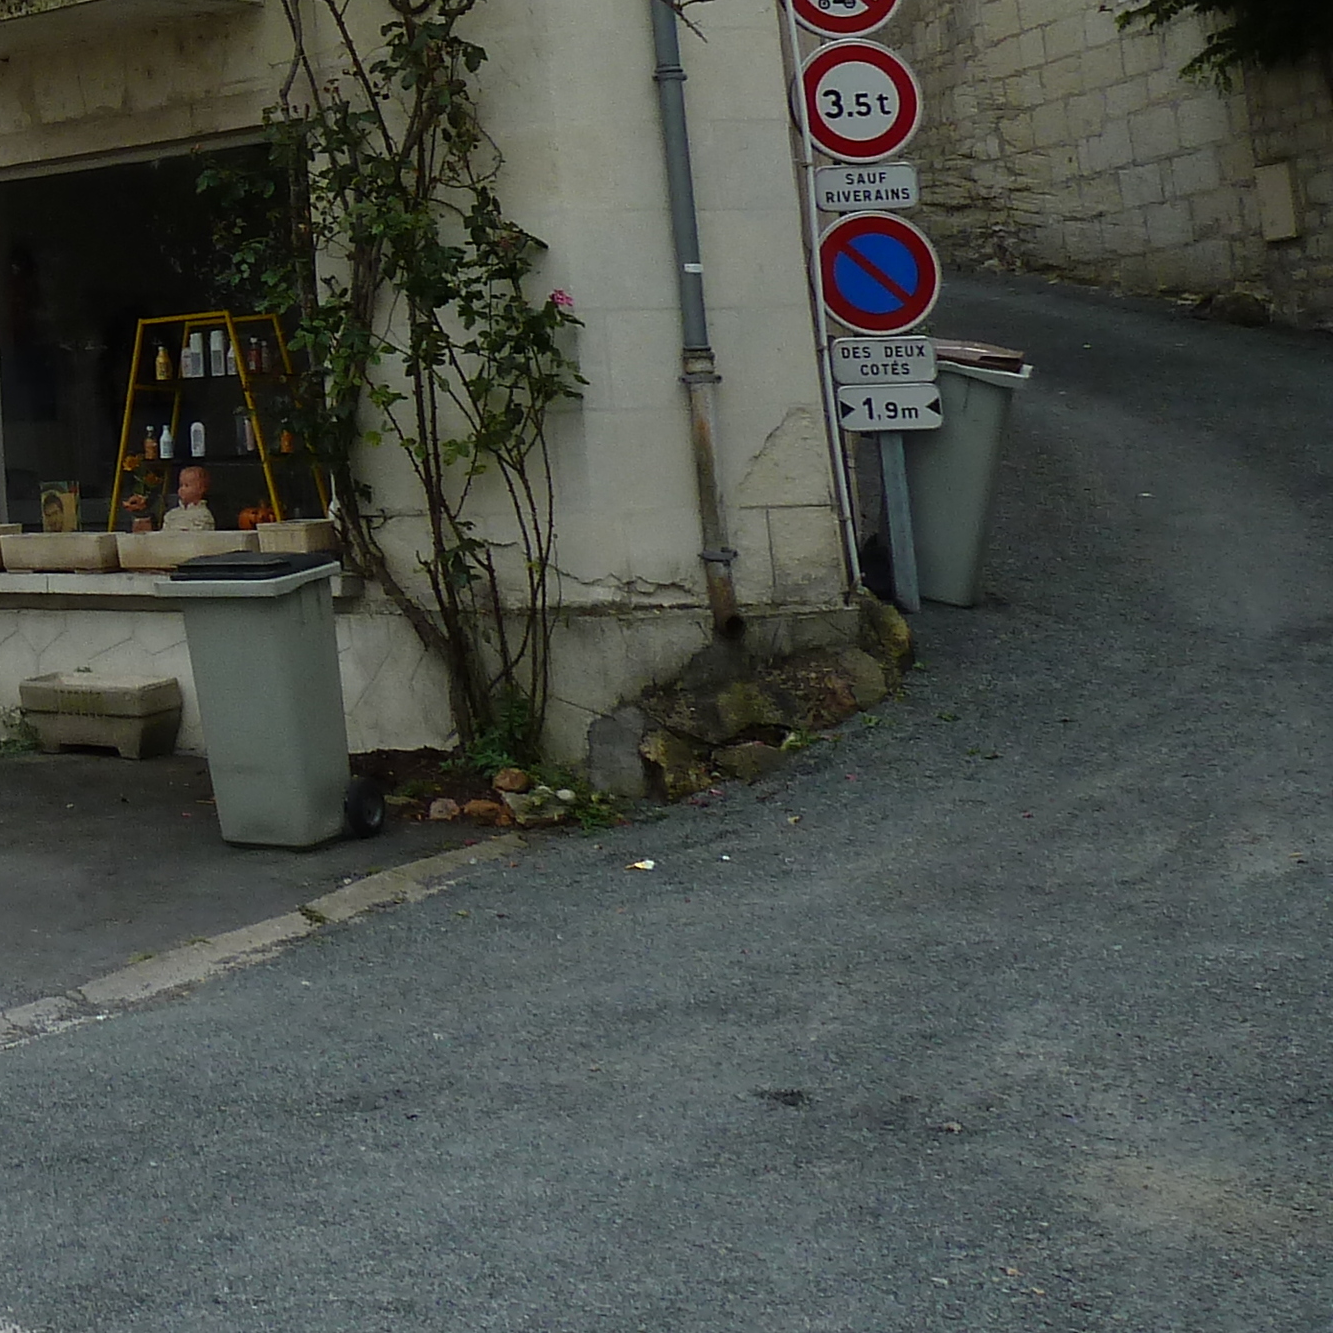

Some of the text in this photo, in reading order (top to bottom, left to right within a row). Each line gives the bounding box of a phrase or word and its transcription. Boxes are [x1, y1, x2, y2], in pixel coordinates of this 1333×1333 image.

[845, 171, 887, 185] SAUF
[825, 187, 911, 204] RIVERAINS
[841, 345, 926, 359] DES DEUX
[860, 360, 910, 376] COTÉS
